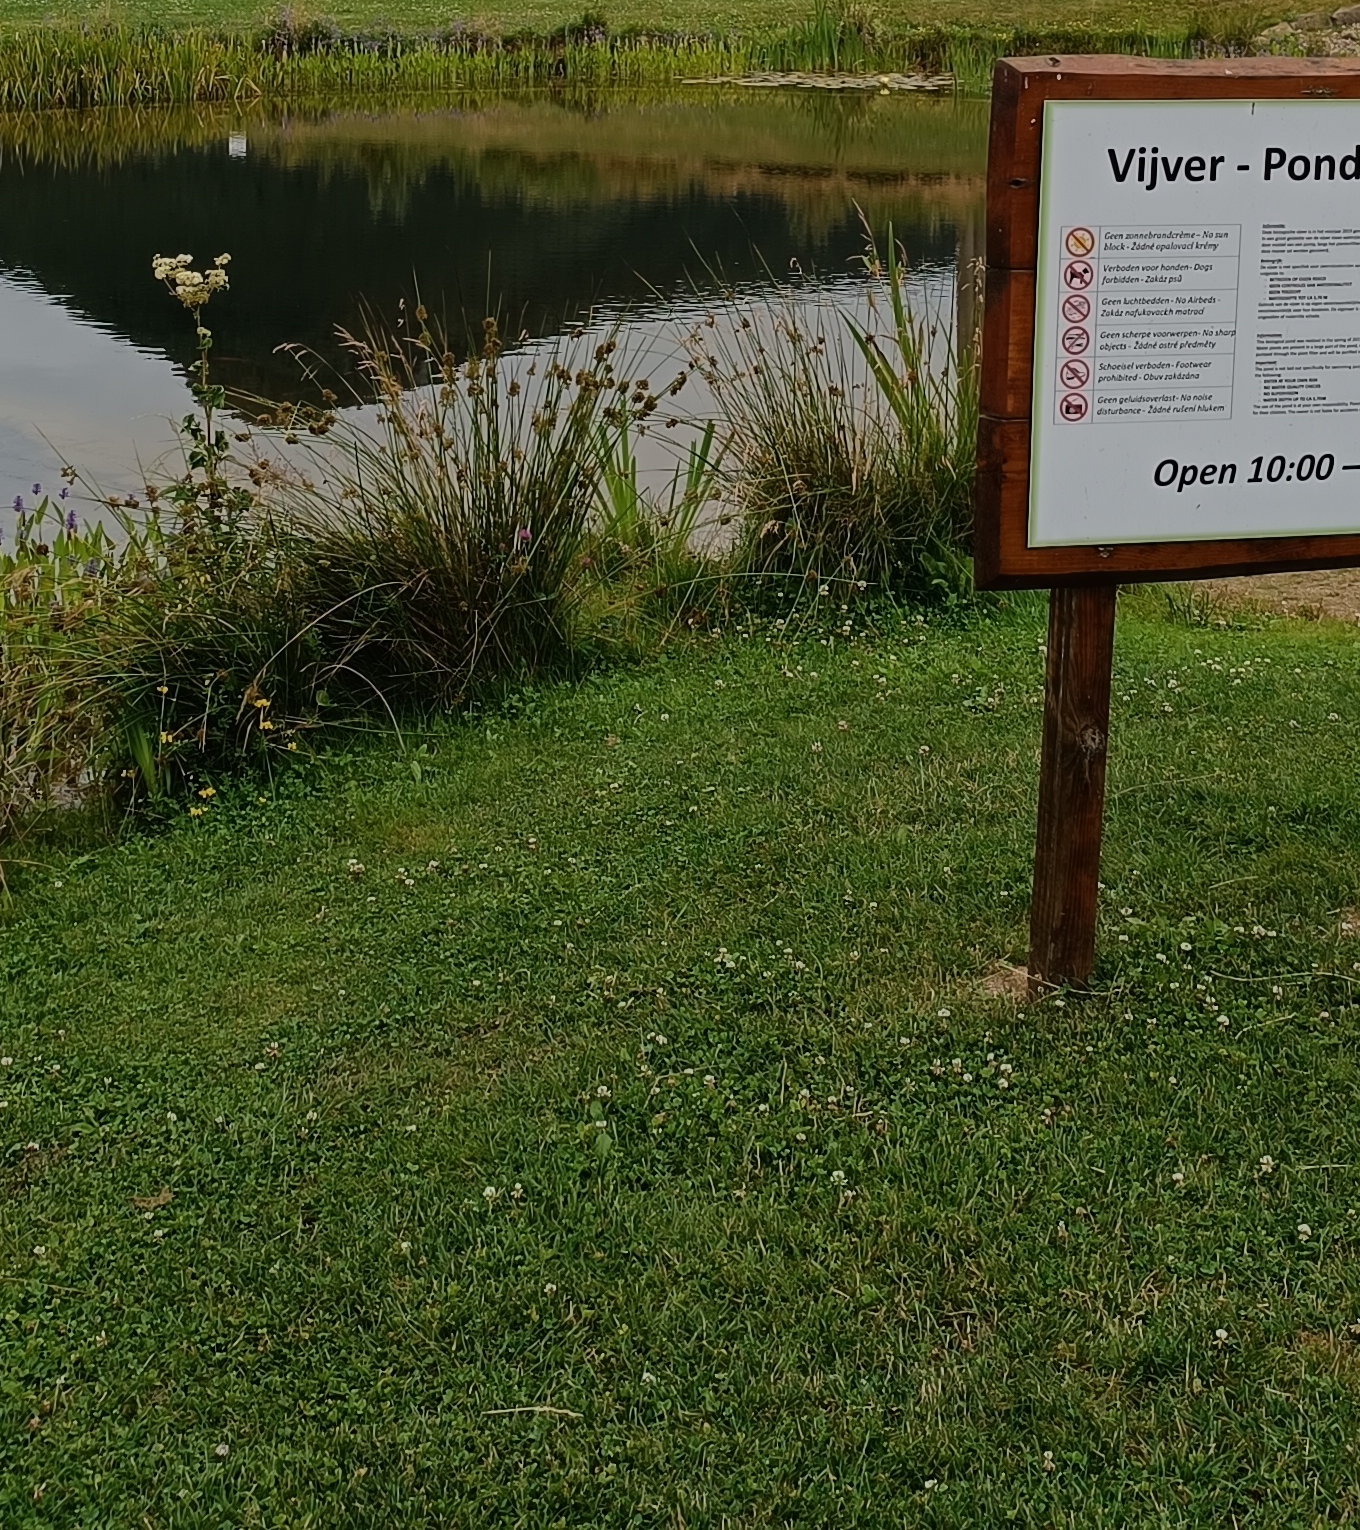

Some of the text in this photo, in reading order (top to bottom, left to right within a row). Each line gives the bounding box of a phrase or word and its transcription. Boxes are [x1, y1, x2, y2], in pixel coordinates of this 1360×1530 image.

[1107, 147, 1225, 191] Vijver
[1104, 232, 1124, 240] Geen
[1202, 231, 1213, 239] No
[1104, 243, 1125, 251] block
[1103, 264, 1140, 272] Verboden
[1194, 263, 1213, 272] Dogs
[1102, 275, 1139, 285] forbidden
[1123, 297, 1170, 305] luchtbedden
[1188, 296, 1216, 304] Airbeds
[1100, 331, 1120, 339] Geen
[1122, 331, 1151, 340] scherpe
[1202, 329, 1213, 337] No
[1215, 329, 1236, 338] sharp
[1100, 342, 1127, 351] objects
[1098, 374, 1137, 383] prohibited
[1143, 373, 1163, 381] Obuv
[1097, 396, 1117, 404] Geen
[1193, 393, 1212, 401] noise
[1097, 407, 1141, 415] disturbance
[1197, 404, 1224, 412] hlukem
[1153, 457, 1237, 492] Open
[1247, 453, 1334, 483] 10:00
